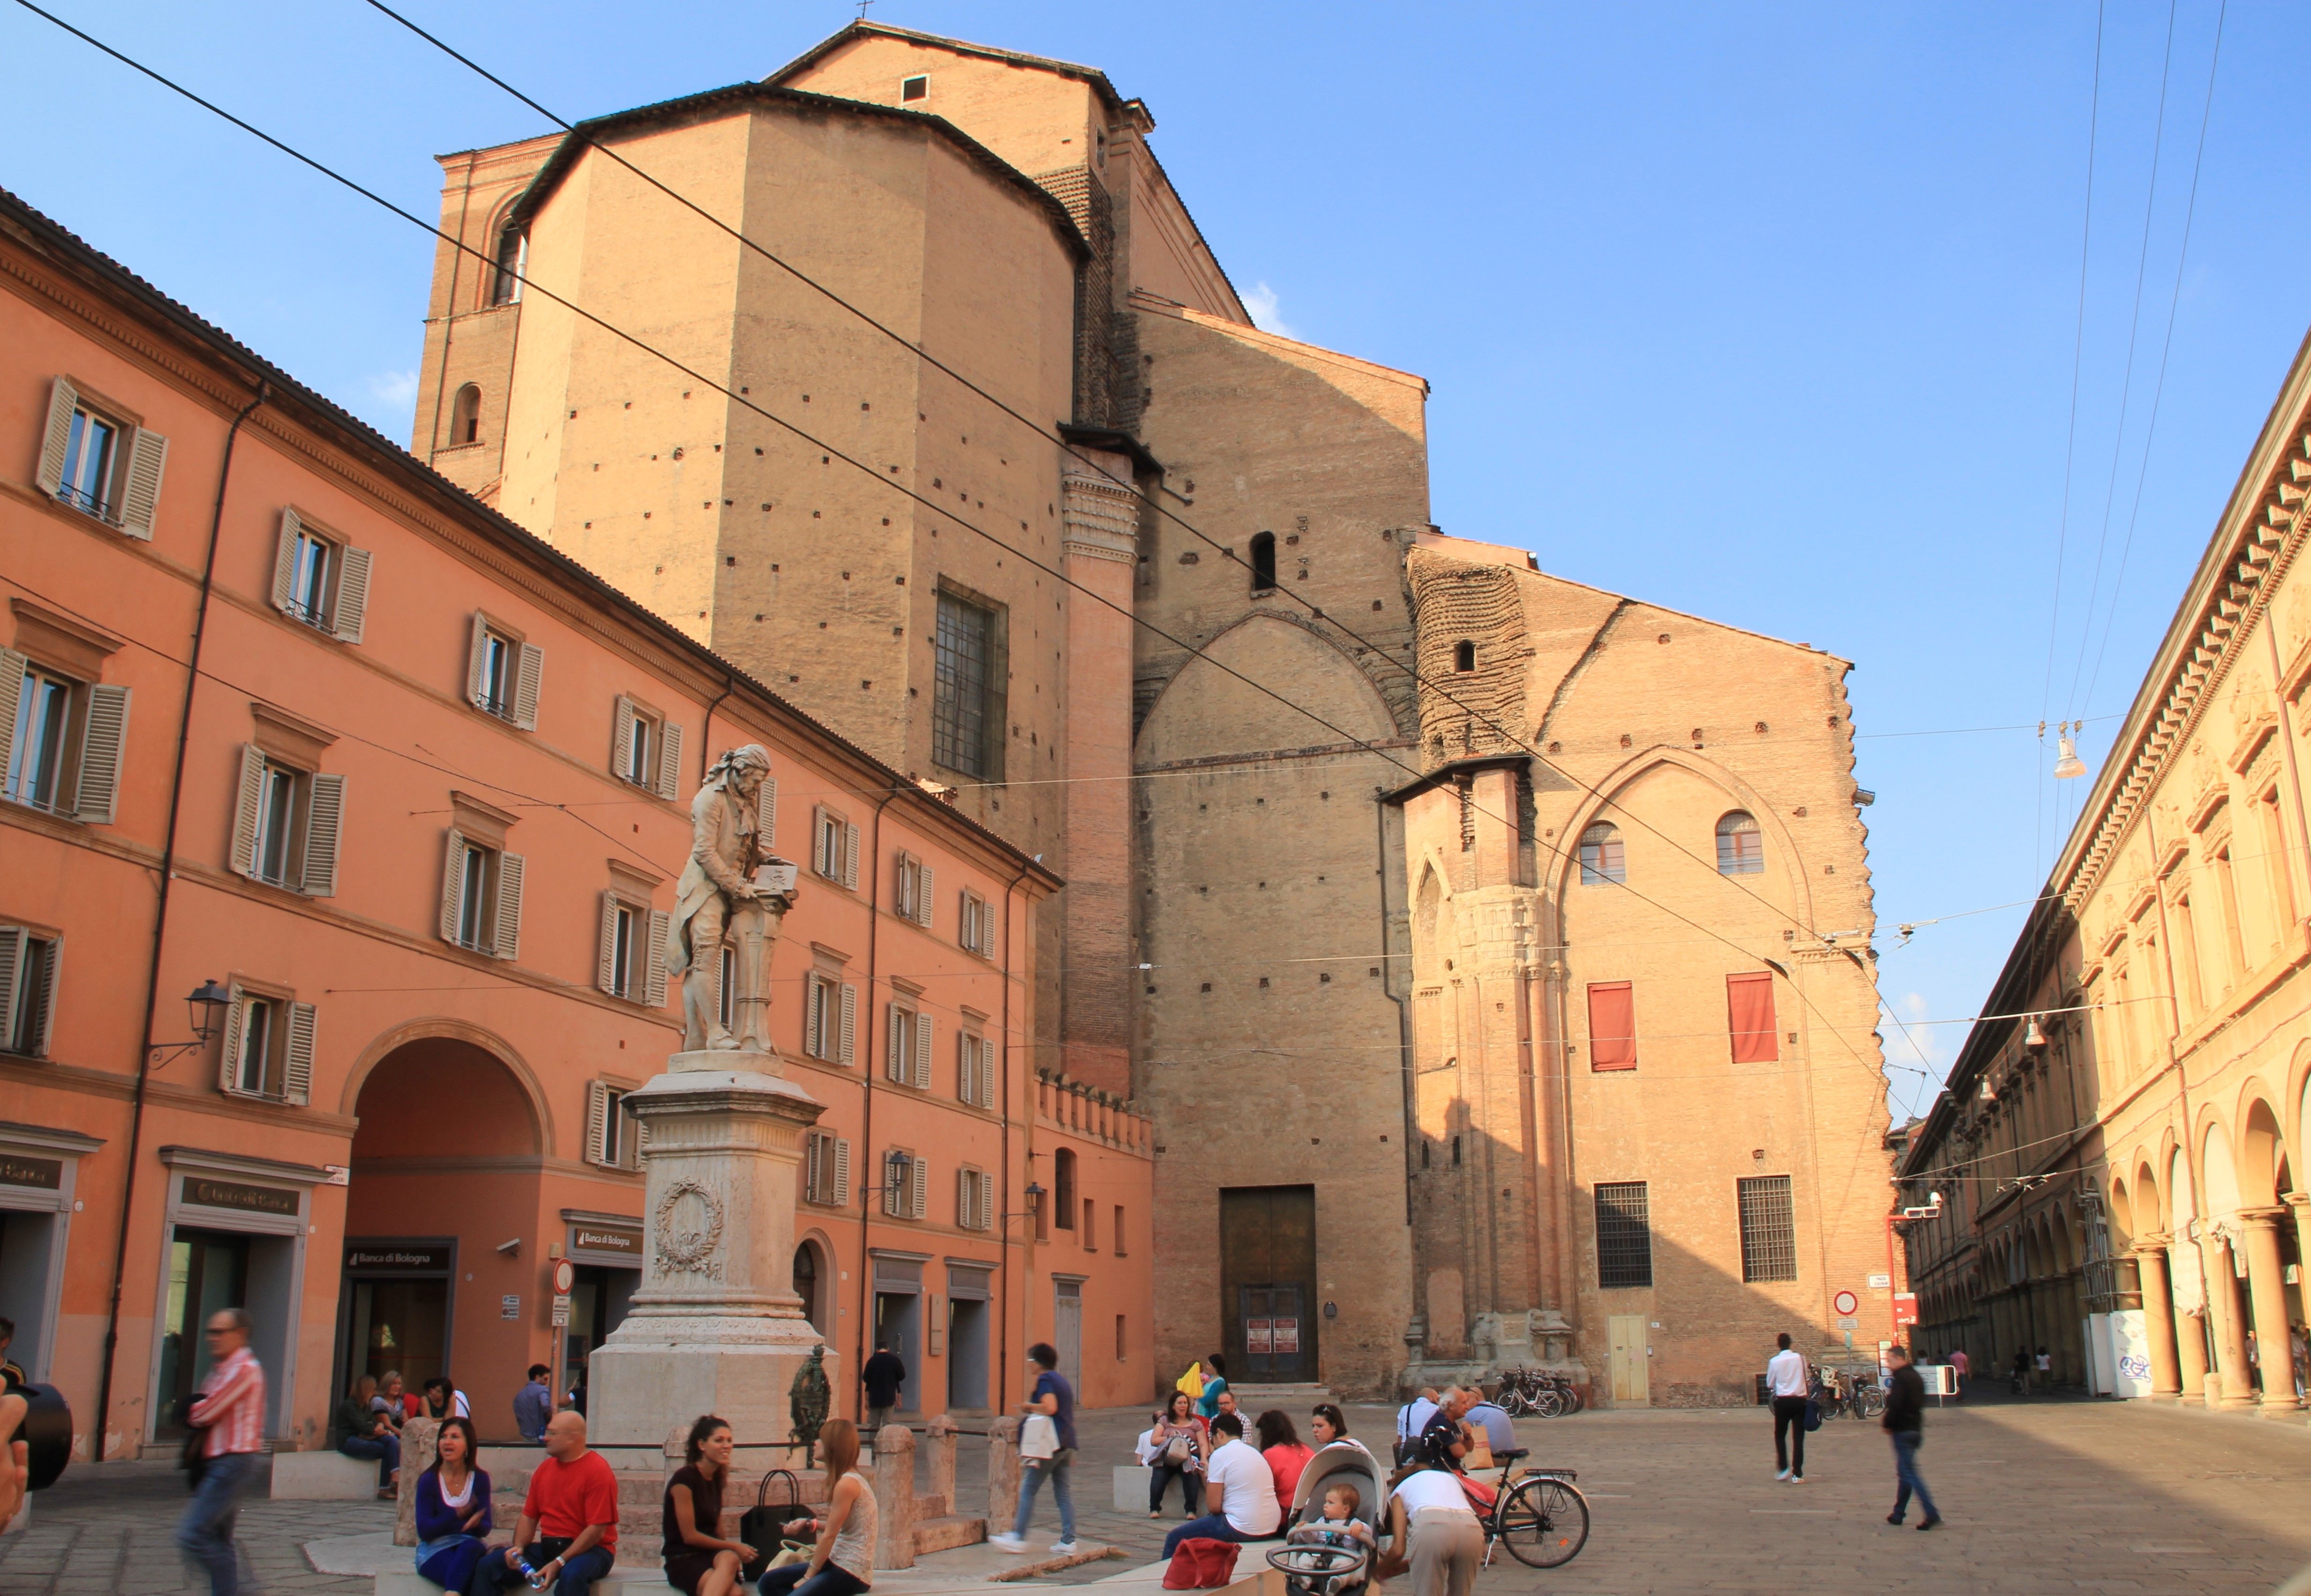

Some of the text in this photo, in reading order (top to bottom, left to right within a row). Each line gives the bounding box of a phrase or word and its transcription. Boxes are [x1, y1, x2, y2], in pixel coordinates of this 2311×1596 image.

[585, 1233, 629, 1247] Banca di Bologna
[359, 1253, 430, 1265] Banca di Bologna
